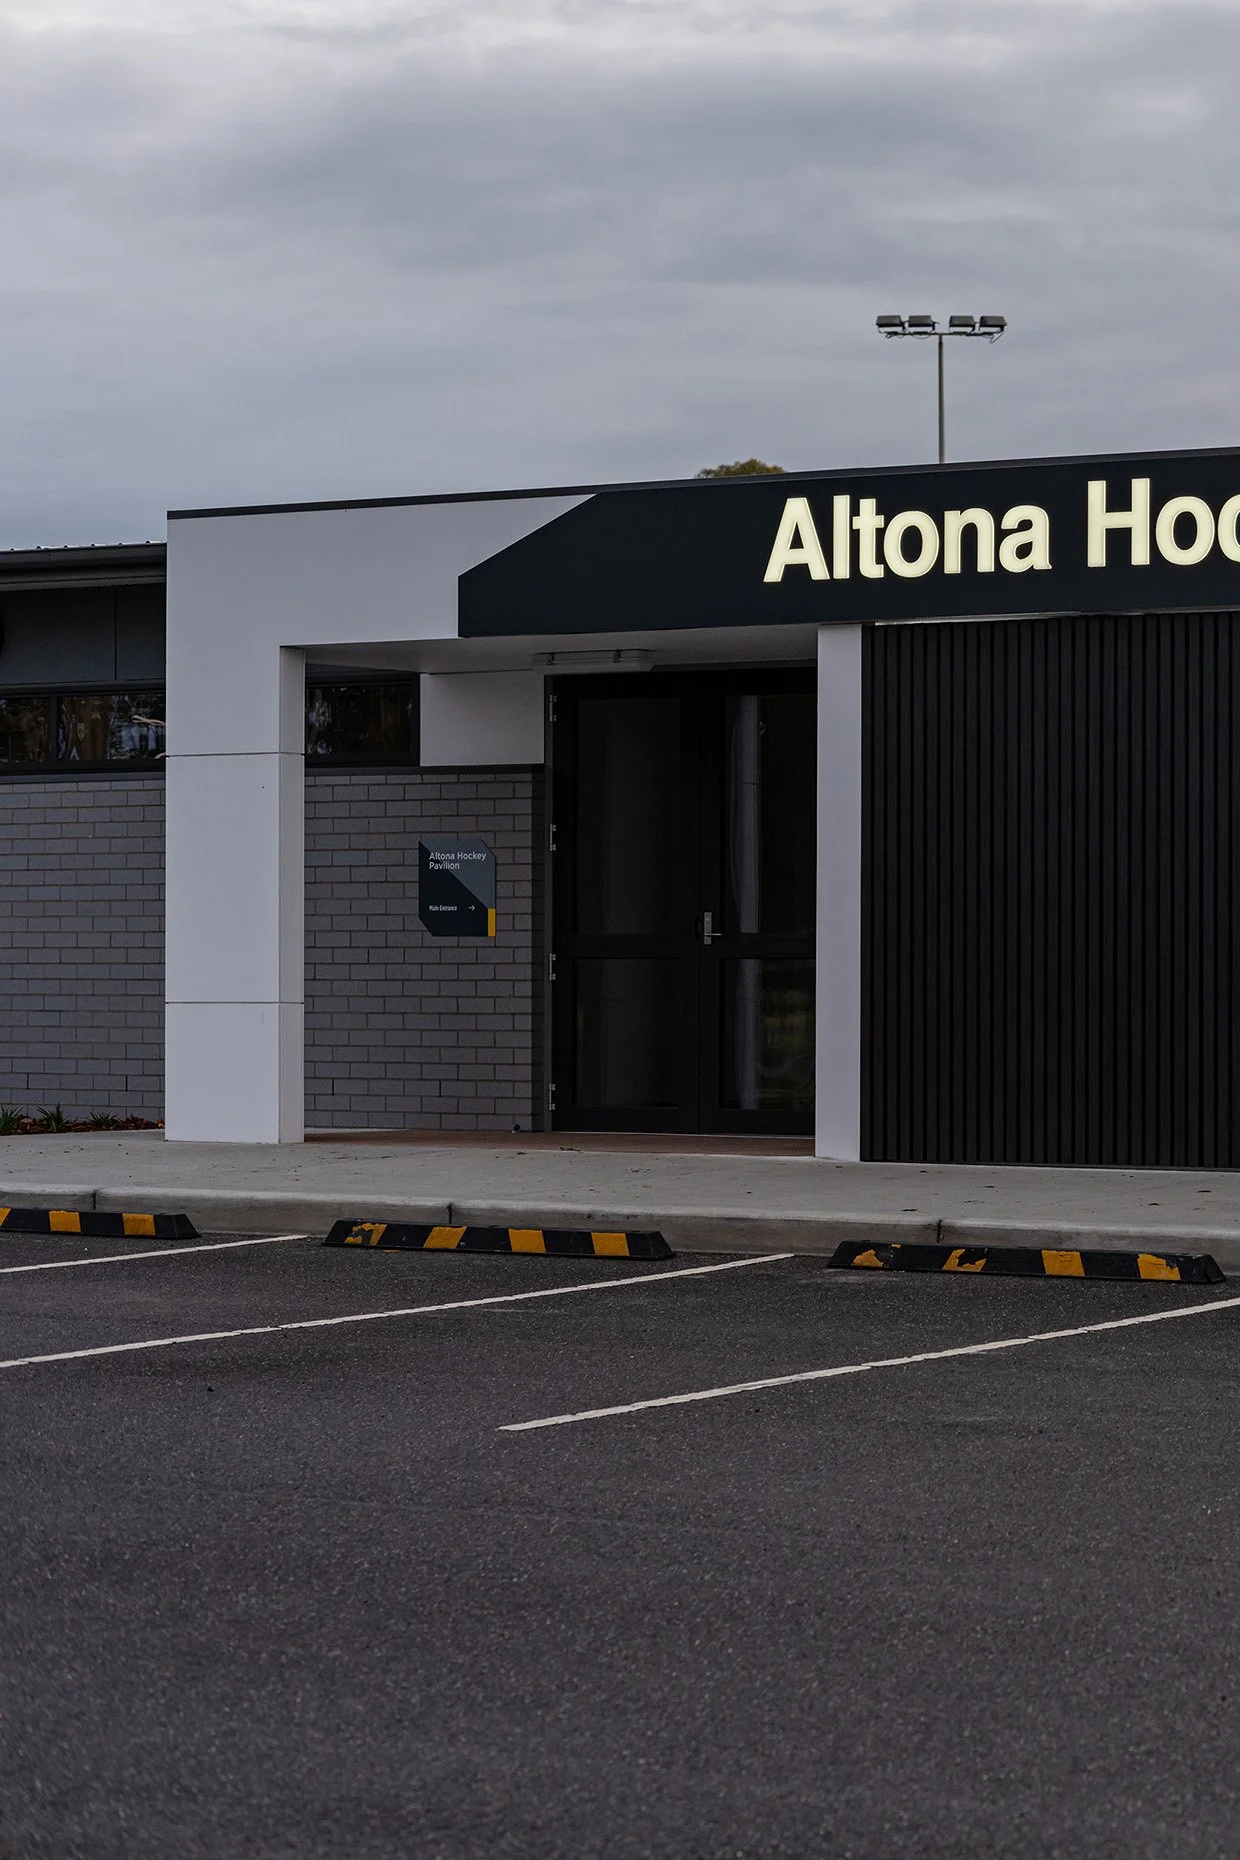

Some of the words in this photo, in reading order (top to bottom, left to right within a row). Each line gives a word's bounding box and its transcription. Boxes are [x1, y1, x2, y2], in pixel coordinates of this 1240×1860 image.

[763, 494, 1052, 584] Altona
[429, 852, 455, 860] Altona
[457, 852, 487, 861] Hockey
[429, 861, 460, 870] Pavilion
